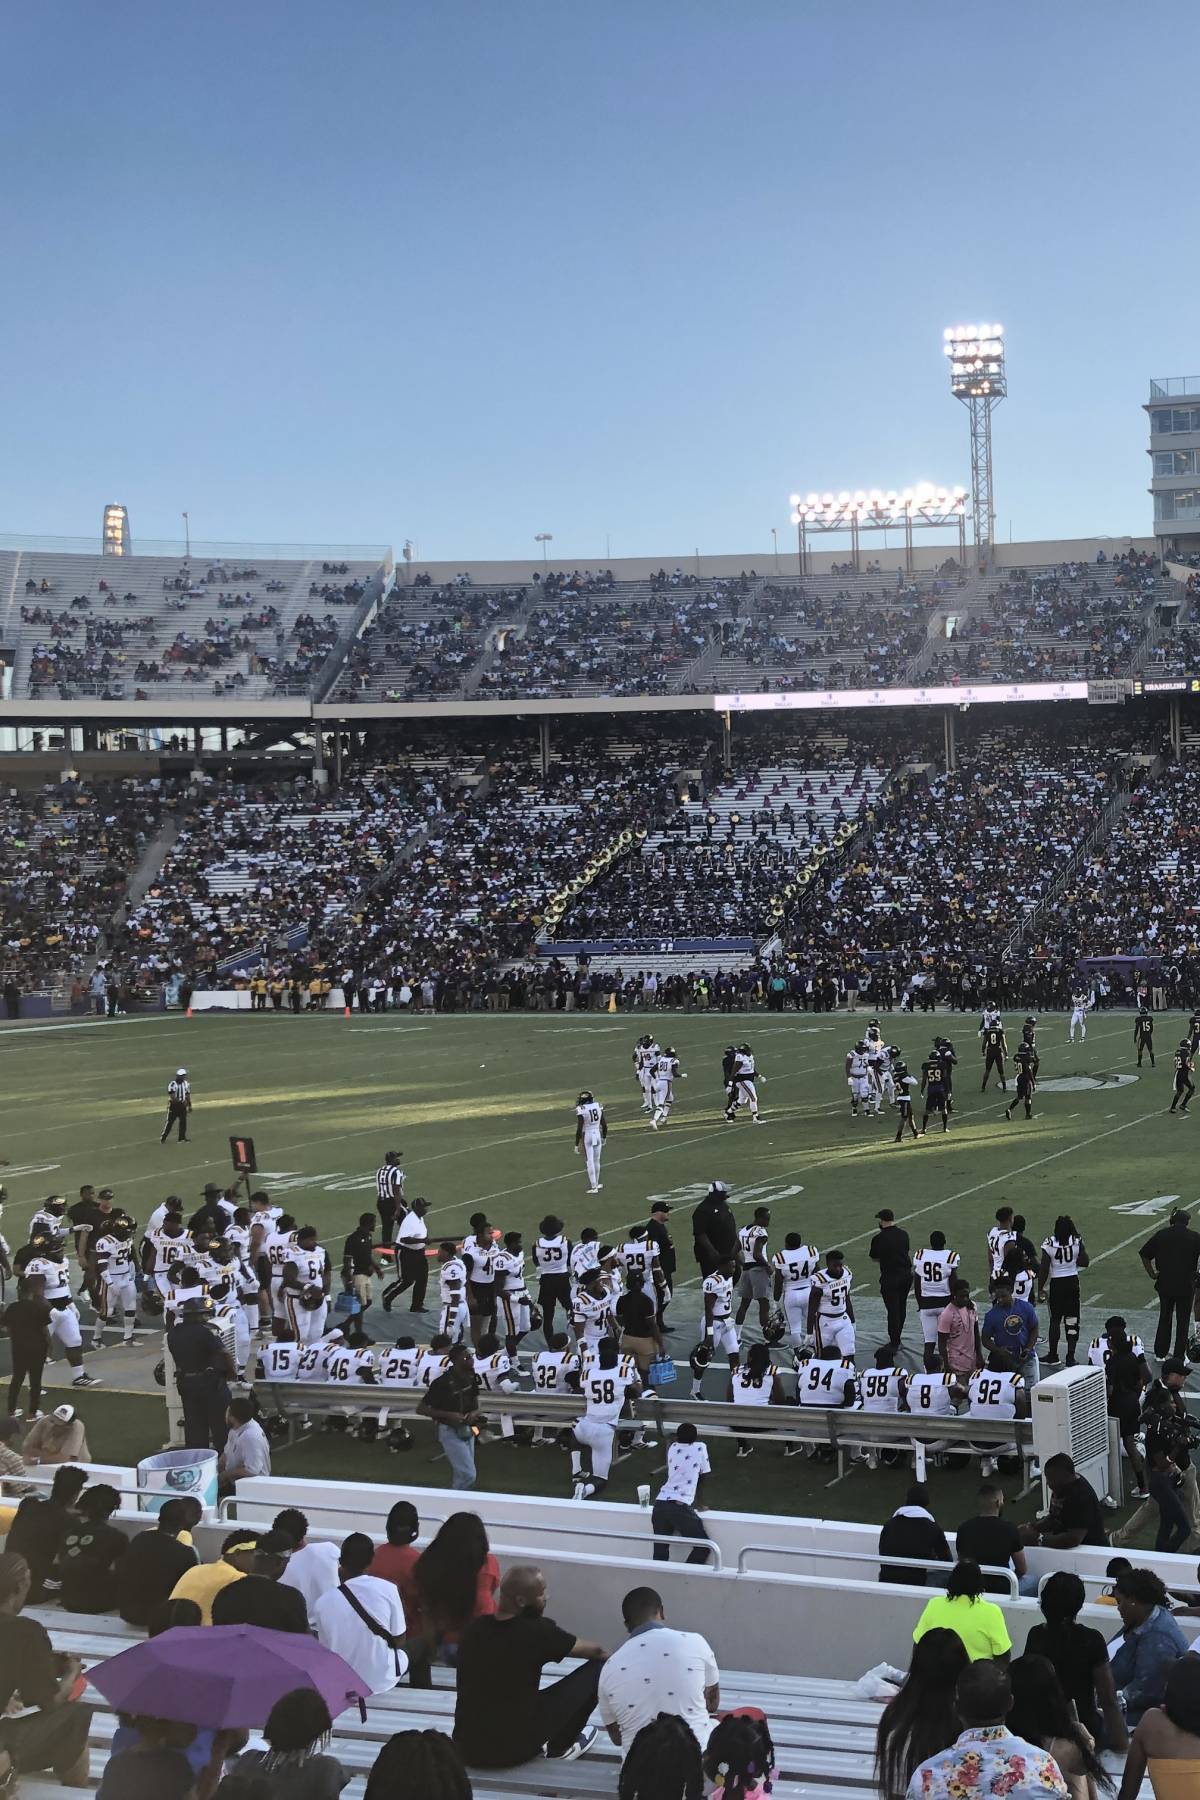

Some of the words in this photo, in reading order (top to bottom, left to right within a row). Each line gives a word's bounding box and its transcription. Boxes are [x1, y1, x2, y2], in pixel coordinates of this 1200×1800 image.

[1144, 682, 1187, 691] GRAMBLING
[990, 1033, 996, 1045] 8
[928, 1069, 941, 1082] 59
[589, 1109, 598, 1122] 18
[236, 1140, 246, 1163] 1
[269, 1246, 284, 1265] 66
[543, 1247, 562, 1263] 33
[626, 1253, 646, 1271] 29
[1054, 1246, 1073, 1264] 40
[789, 1260, 810, 1282] 54
[923, 1262, 942, 1283] 96
[831, 1286, 848, 1307] 57
[272, 1349, 290, 1371] 15
[330, 1358, 349, 1381] 46
[385, 1359, 411, 1379] 25
[537, 1365, 557, 1388] 32
[808, 1367, 834, 1391] 94
[866, 1375, 889, 1397] 98
[591, 1379, 614, 1404] 58
[920, 1384, 931, 1408] 8
[977, 1379, 1001, 1404] 92
